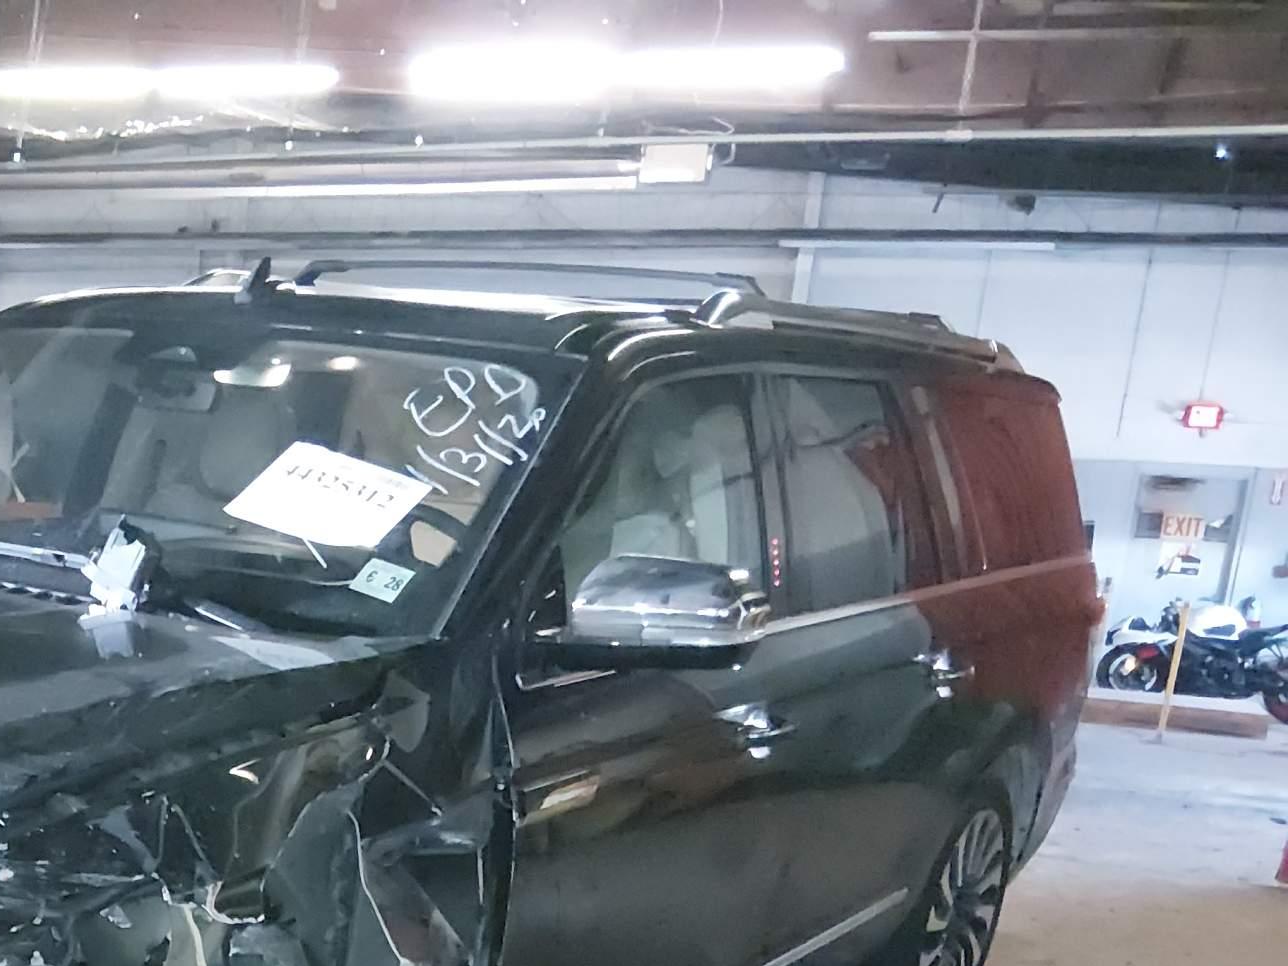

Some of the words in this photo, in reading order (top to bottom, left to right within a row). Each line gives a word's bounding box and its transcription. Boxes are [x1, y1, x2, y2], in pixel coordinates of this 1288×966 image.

[403, 363, 528, 437] EPD
[1163, 513, 1203, 537] EXIT
[383, 576, 404, 592] 28
